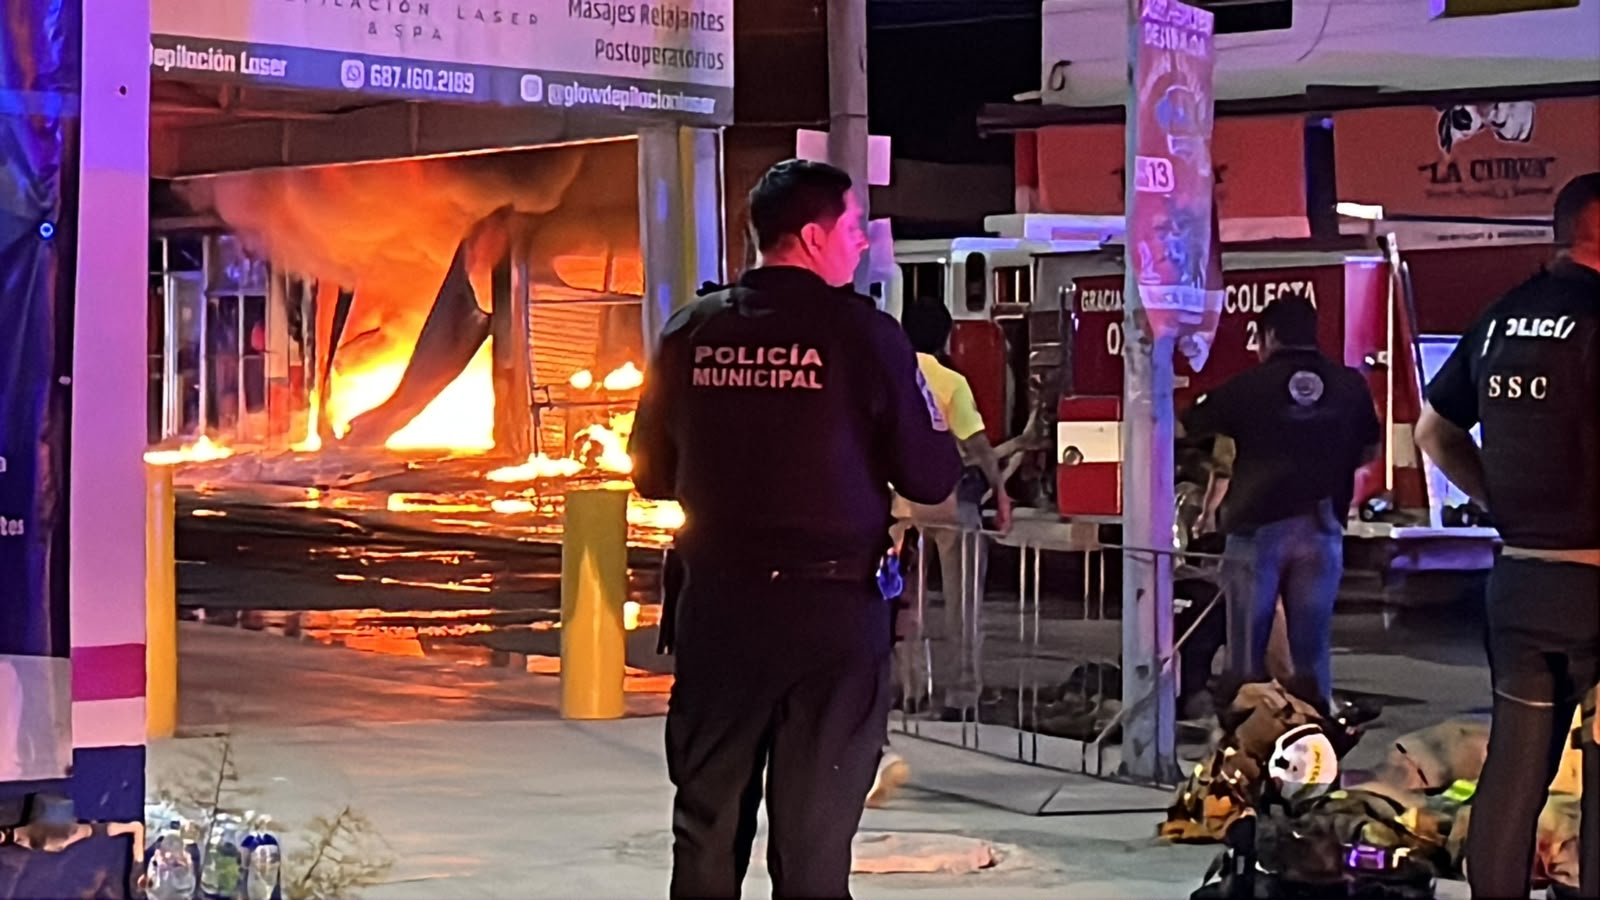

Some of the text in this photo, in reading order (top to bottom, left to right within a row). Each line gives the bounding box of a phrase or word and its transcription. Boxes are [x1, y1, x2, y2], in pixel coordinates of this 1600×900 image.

[456, 7, 538, 26] LASER
[568, 0, 725, 33] Masajes Relajantes
[394, 24, 442, 41] SPA
[150, 43, 288, 77] epilación Laser
[594, 38, 725, 71] Postoperatorios
[370, 64, 475, 94] 687.160.2189
[1081, 289, 1124, 312] GRACIA
[694, 344, 823, 366] POLICÍA
[692, 368, 823, 389] MUNICIPAL
